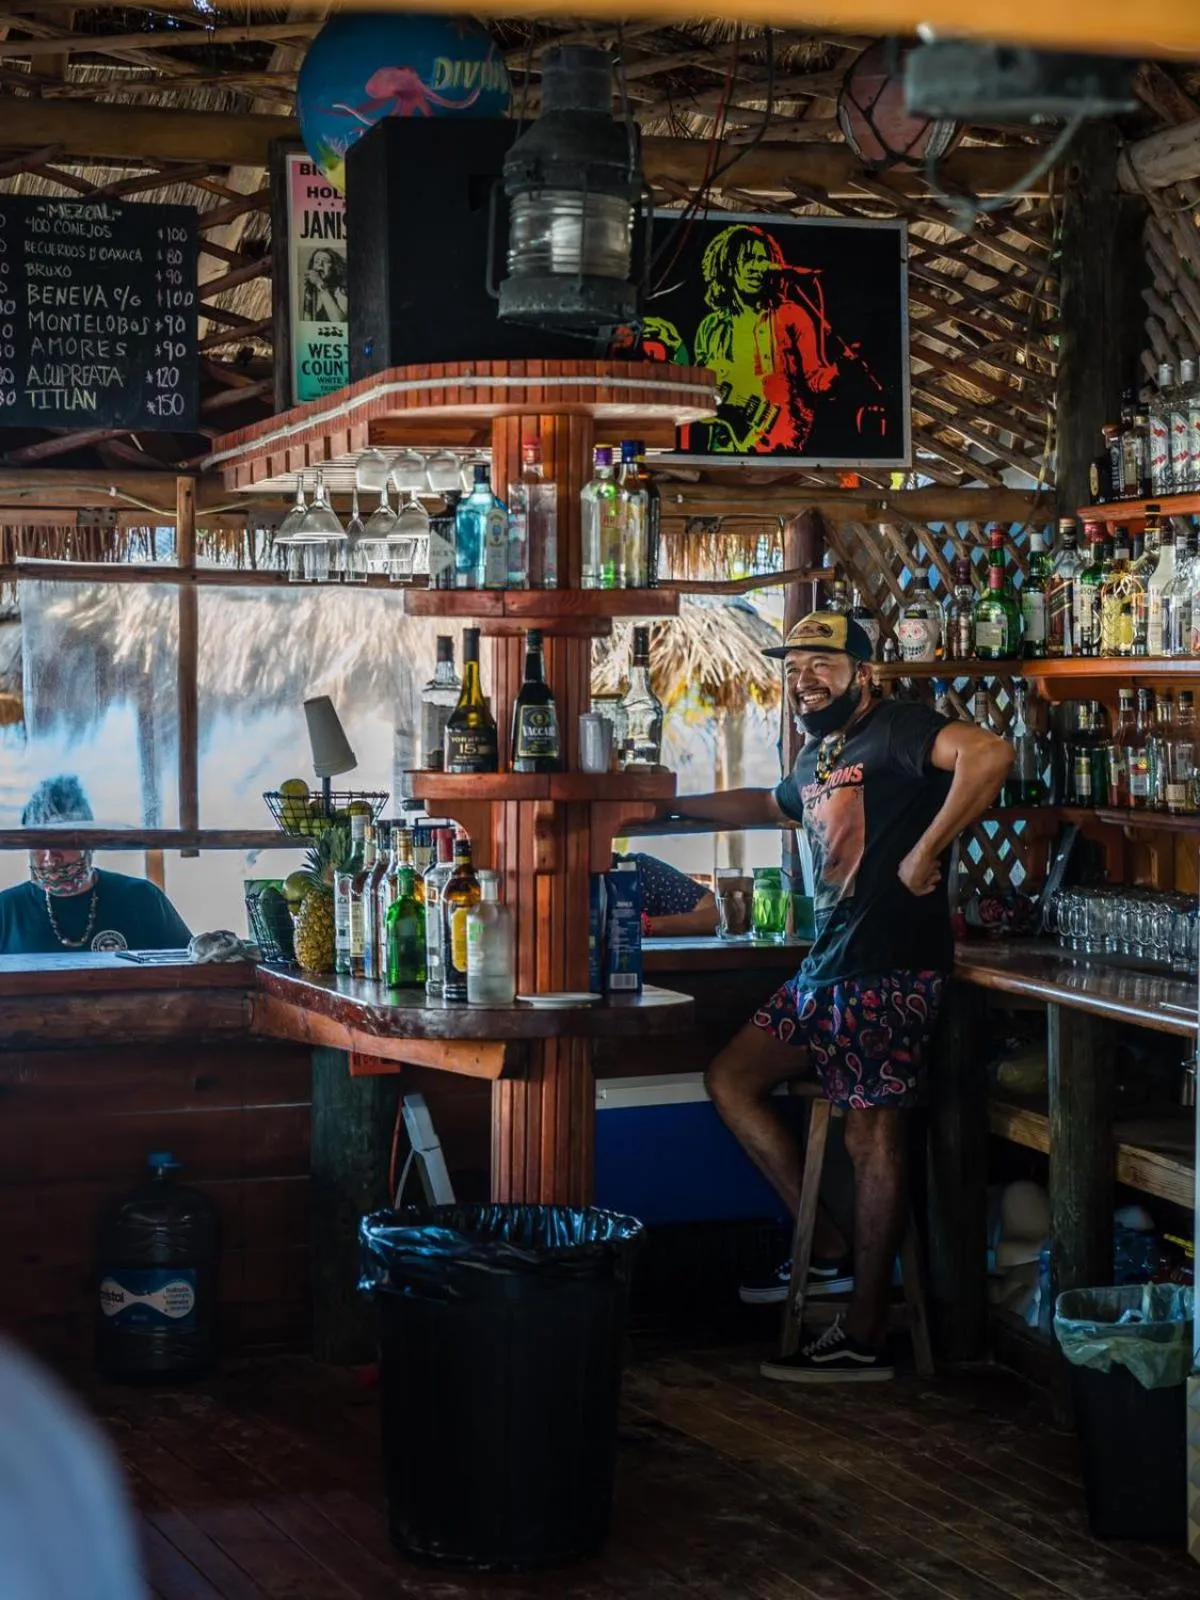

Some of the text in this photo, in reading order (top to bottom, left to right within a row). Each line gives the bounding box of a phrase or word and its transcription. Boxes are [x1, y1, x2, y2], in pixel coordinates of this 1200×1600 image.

[25, 216, 50, 233] 400
[54, 220, 112, 239] CONEJOS
[24, 240, 86, 259] RECUERDOS
[25, 262, 73, 279] BRUXO
[27, 284, 108, 308] BENEVA
[28, 311, 150, 336] MONTELOBOS
[31, 337, 128, 360] AMORES
[24, 387, 97, 410] TITLAN
[459, 743, 477, 755] 15
